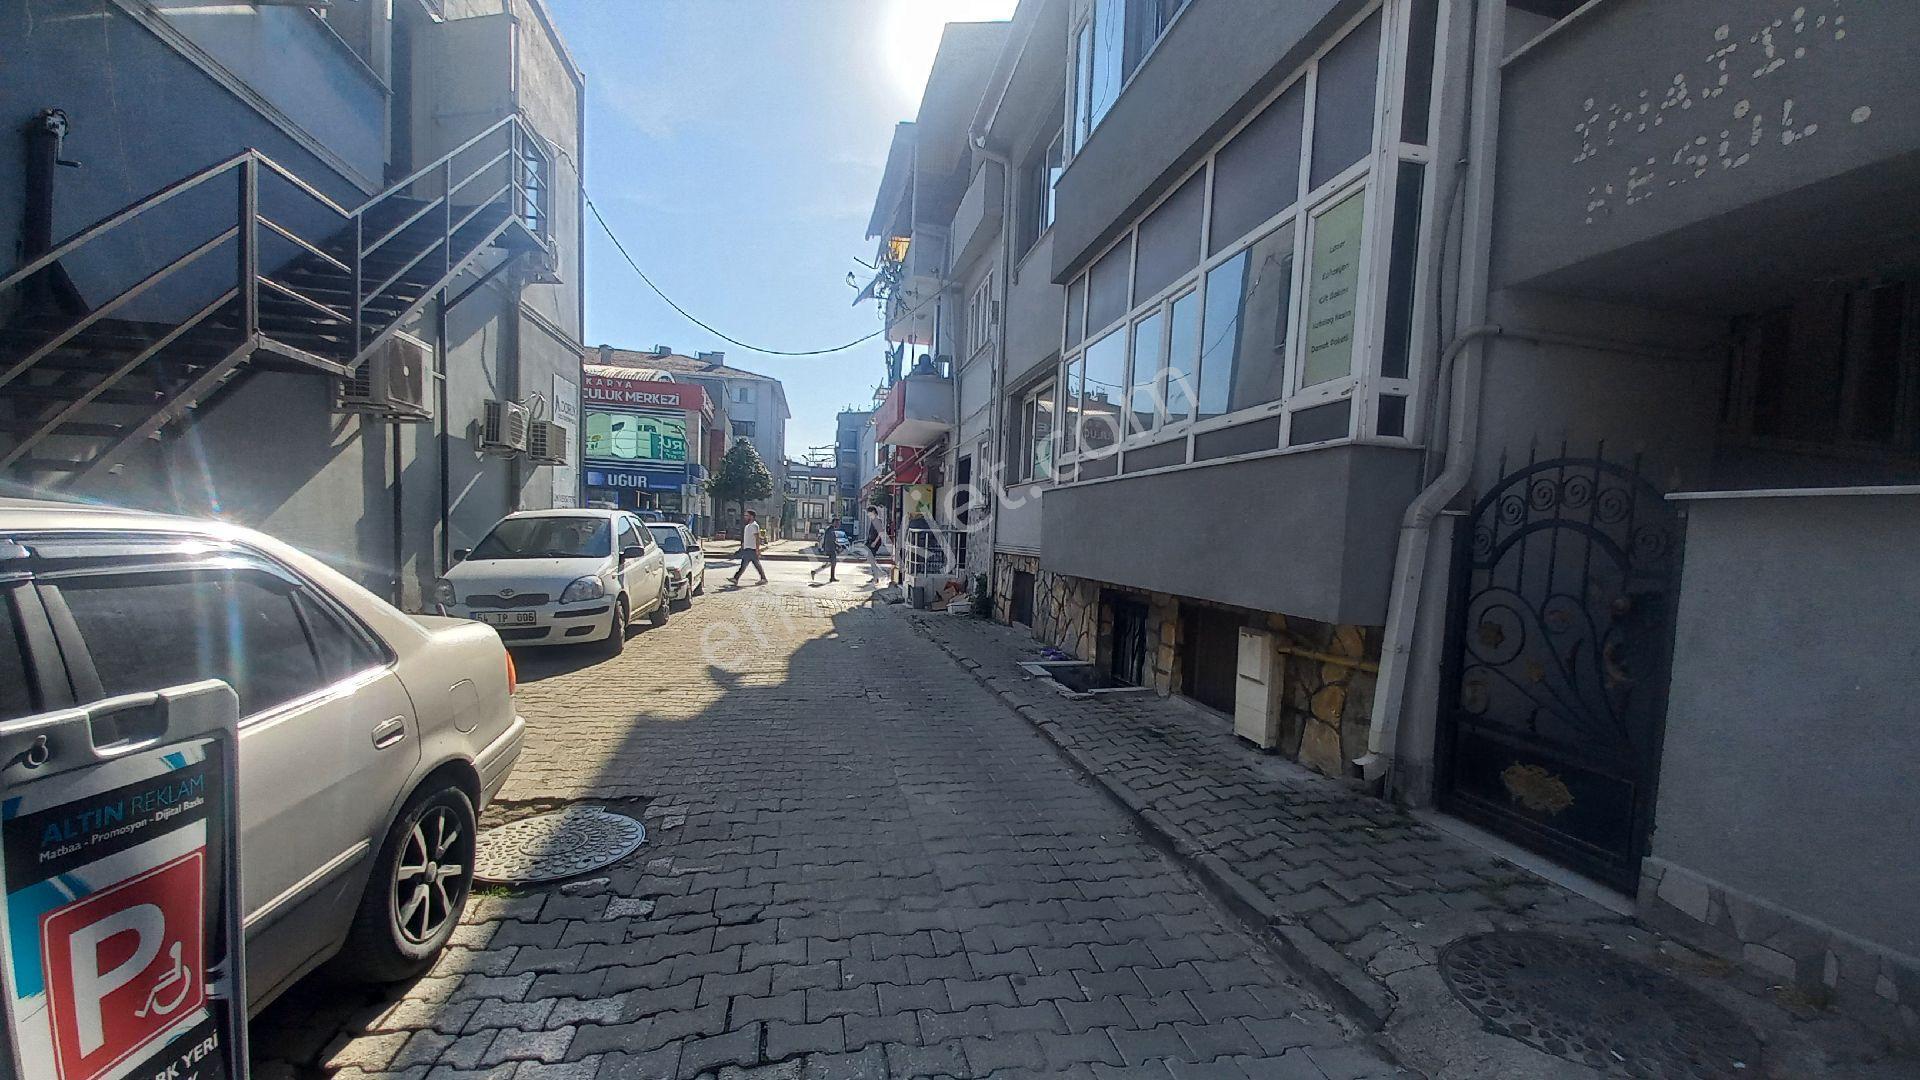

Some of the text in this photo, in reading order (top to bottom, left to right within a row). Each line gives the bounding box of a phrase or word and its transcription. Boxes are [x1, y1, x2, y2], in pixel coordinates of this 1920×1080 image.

[625, 391, 679, 406] MERKEZİ
[607, 473, 647, 488] UĞUR
[42, 772, 204, 846] ALTIN REKLAM
[39, 840, 82, 863] Matbaa
[91, 818, 148, 846] Promosyon
[155, 806, 182, 823] Dijital
[69, 903, 166, 1060] P
[181, 1029, 218, 1068] YERİ
